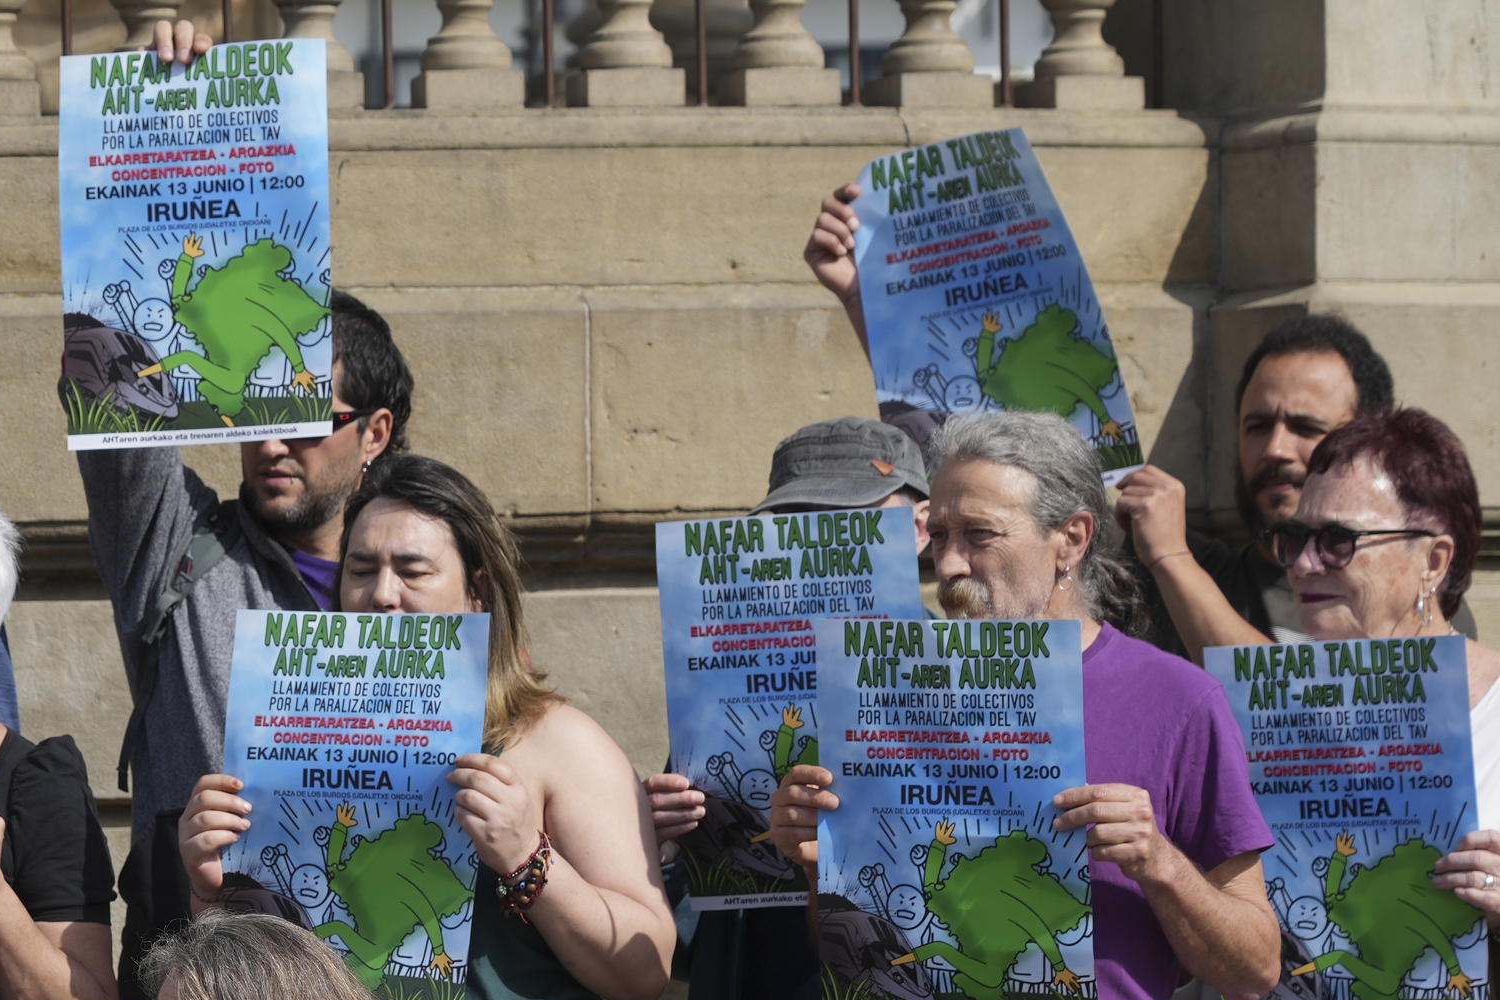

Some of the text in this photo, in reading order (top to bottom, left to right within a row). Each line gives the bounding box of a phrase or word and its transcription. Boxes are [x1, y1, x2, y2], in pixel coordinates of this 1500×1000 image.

[204, 76, 281, 109] AURKA
[103, 109, 279, 134] LLAMAMIENTO DE COLECTIVOS
[101, 125, 282, 151] POR LA PARALIZACION DEL TAV
[871, 129, 1021, 191] NAFAR TALDEOK
[146, 195, 242, 223] IRUÑEA
[886, 243, 1068, 295] EKAINAK 13 JUNIO 12:00
[943, 271, 1029, 308] IRUÑEA
[684, 510, 885, 557] NAFAR TALDEOK
[798, 545, 874, 579] AURKA
[262, 613, 461, 651] NAFAR TALDEOK
[844, 621, 1050, 658] NAFAR TALDEOK
[371, 649, 448, 680] AURKA
[688, 652, 786, 672] EKAINAK 13
[959, 658, 1036, 689] AURKA
[1236, 639, 1437, 682] NAFAR TALDEOK
[1351, 673, 1427, 706] AURKA
[254, 715, 454, 732] ELKARRETARATZEA ARGAZKIA
[845, 730, 1052, 744] ELKARRETARATZEA ARGAZKIA
[271, 731, 431, 747] CONCENTRACION FOTO
[302, 764, 394, 790] IRUÑEA
[842, 762, 1061, 780] EKAINAK 13 JUNIO 12:00
[1319, 775, 1454, 793] 13 JUNIO 12:00
[900, 780, 995, 806] IRUÑEA
[1298, 793, 1392, 820] IRUÑEA
